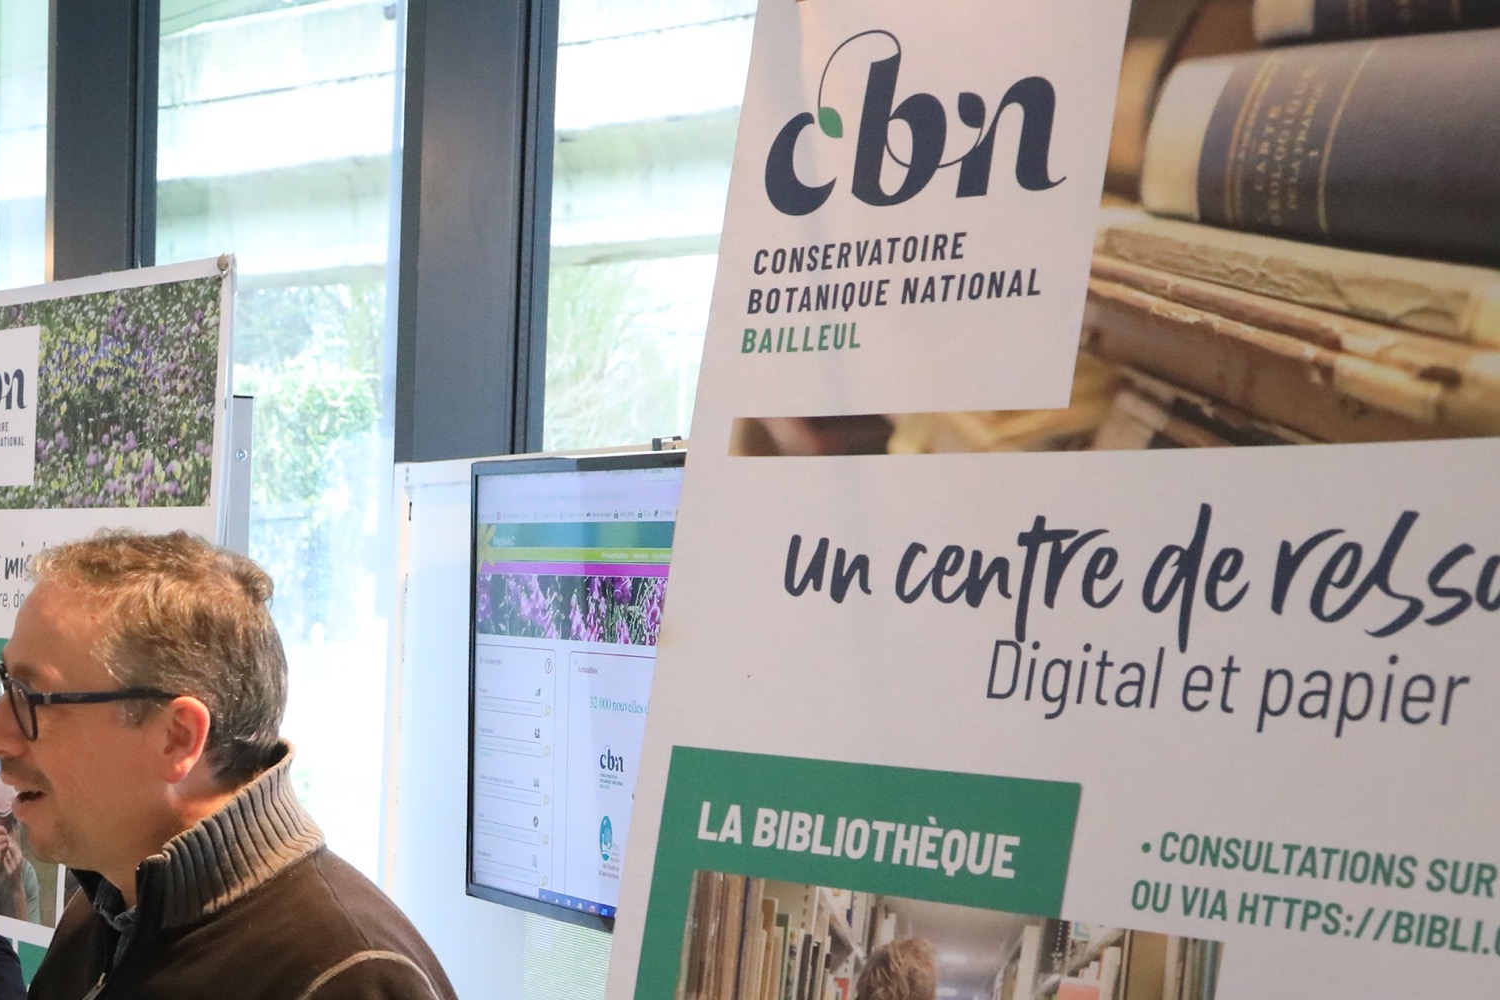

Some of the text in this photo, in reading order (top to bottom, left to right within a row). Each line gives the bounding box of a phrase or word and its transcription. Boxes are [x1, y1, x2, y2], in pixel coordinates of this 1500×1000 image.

[765, 29, 1066, 216] cbn
[753, 231, 968, 276] CONSERVATOIRE
[747, 268, 1042, 315] BOTANIQUE NATIONAL
[740, 321, 861, 356] BAILLEUL
[783, 533, 871, 603] un
[895, 514, 1124, 643] centre
[1142, 503, 1250, 654] de
[599, 697, 612, 711] 000
[612, 699, 643, 715] nouvelles
[985, 639, 1470, 738] Digital et papier
[599, 745, 624, 773] cbn
[698, 801, 1021, 880] LA BIBLIOTHÈQUE
[1159, 831, 1497, 898] CONSULTATIONS SUR
[1131, 880, 1172, 913] OU
[1180, 885, 1228, 921] VIA
